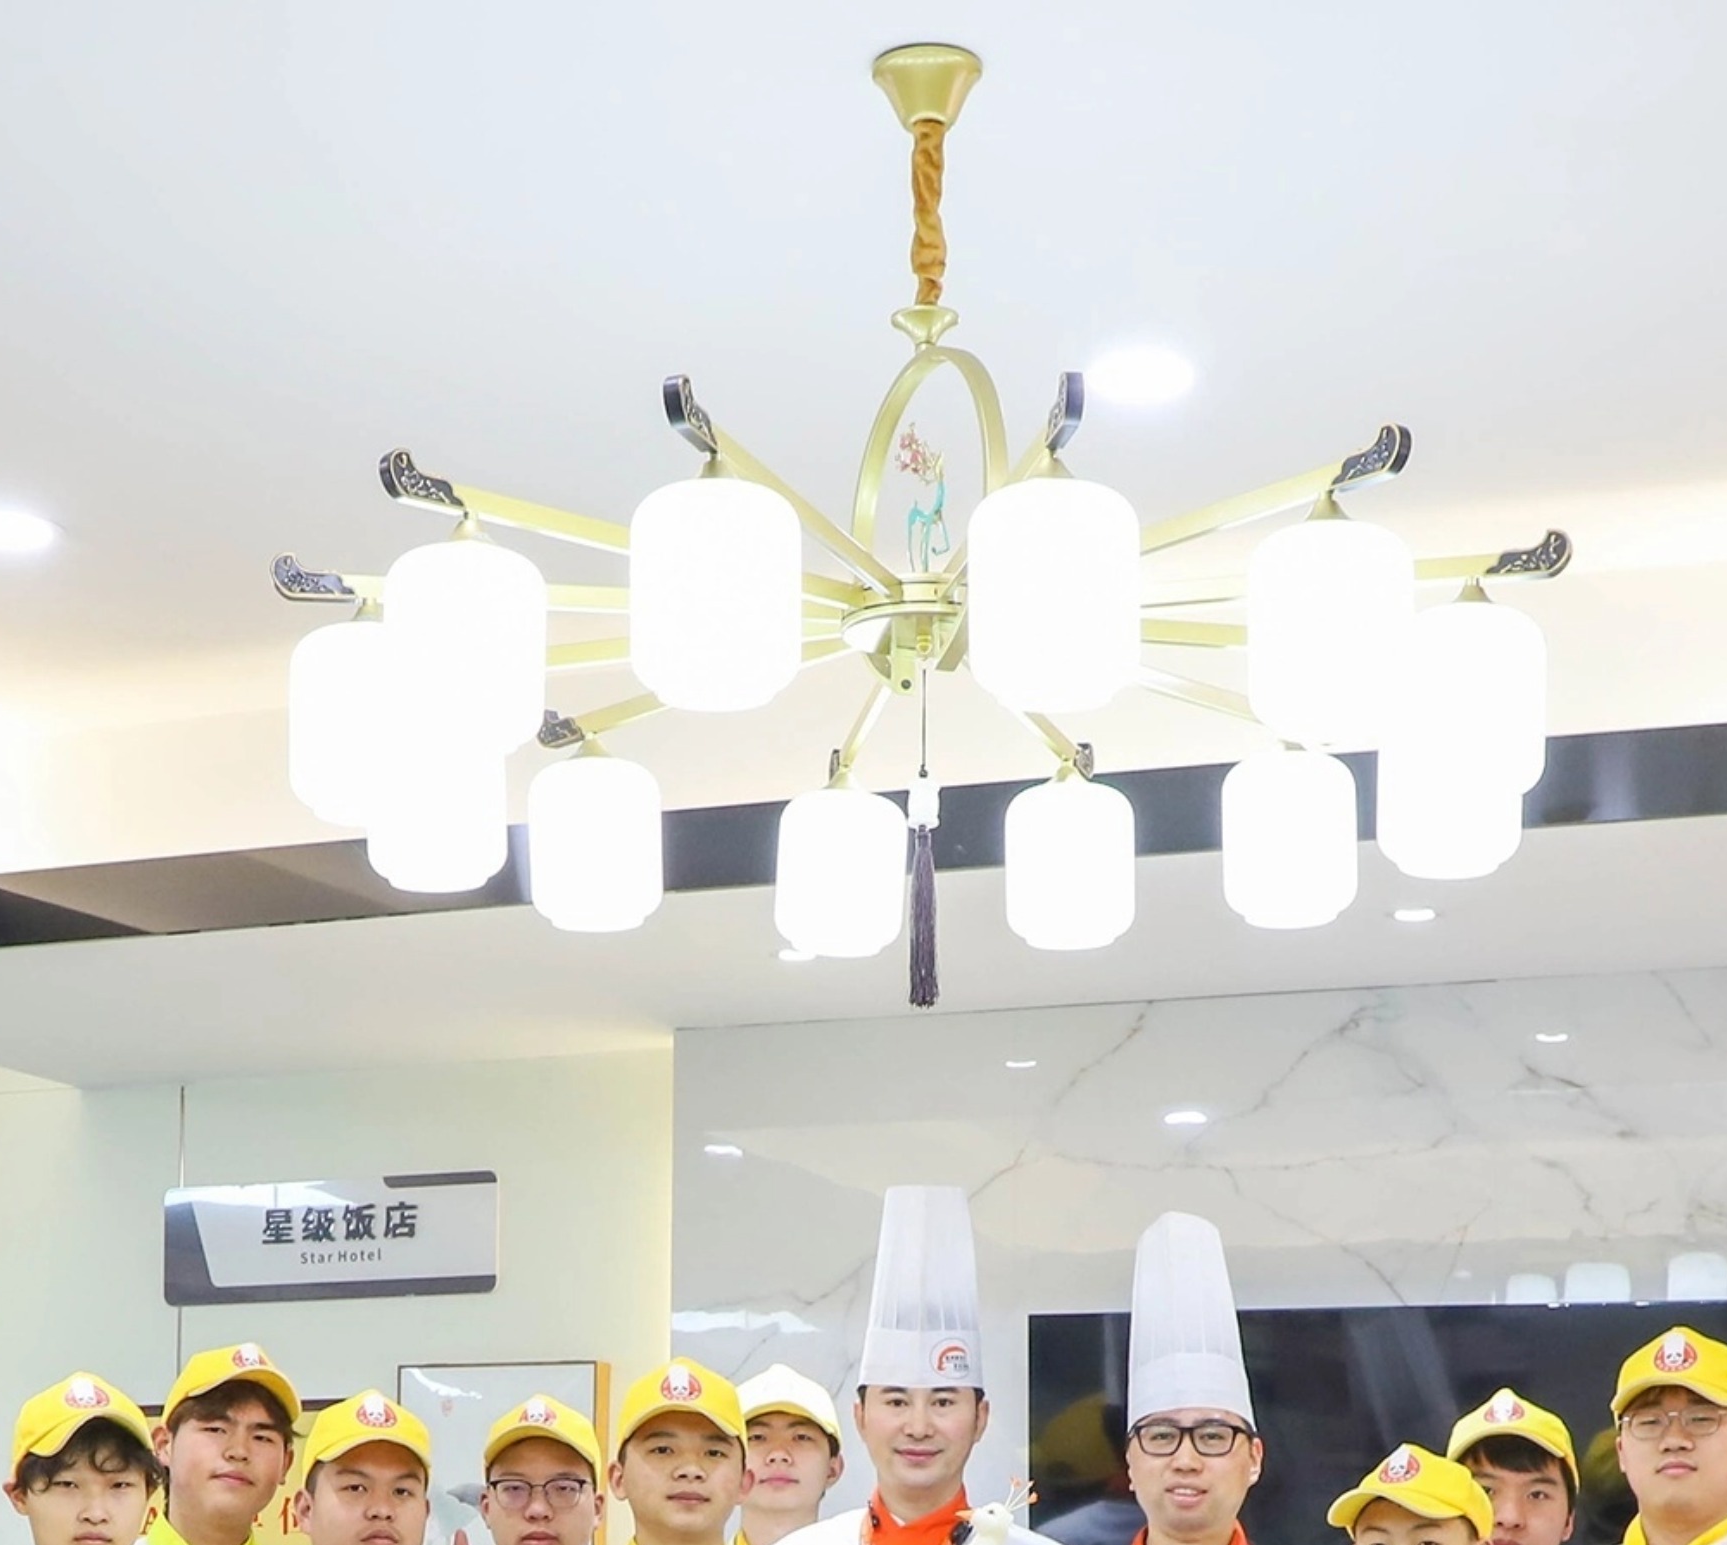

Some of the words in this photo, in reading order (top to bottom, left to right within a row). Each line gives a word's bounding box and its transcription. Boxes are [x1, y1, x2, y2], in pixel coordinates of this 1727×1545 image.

[260, 1201, 420, 1246] 星级饭店
[299, 1251, 334, 1265] Star
[337, 1247, 383, 1263] Hotel
